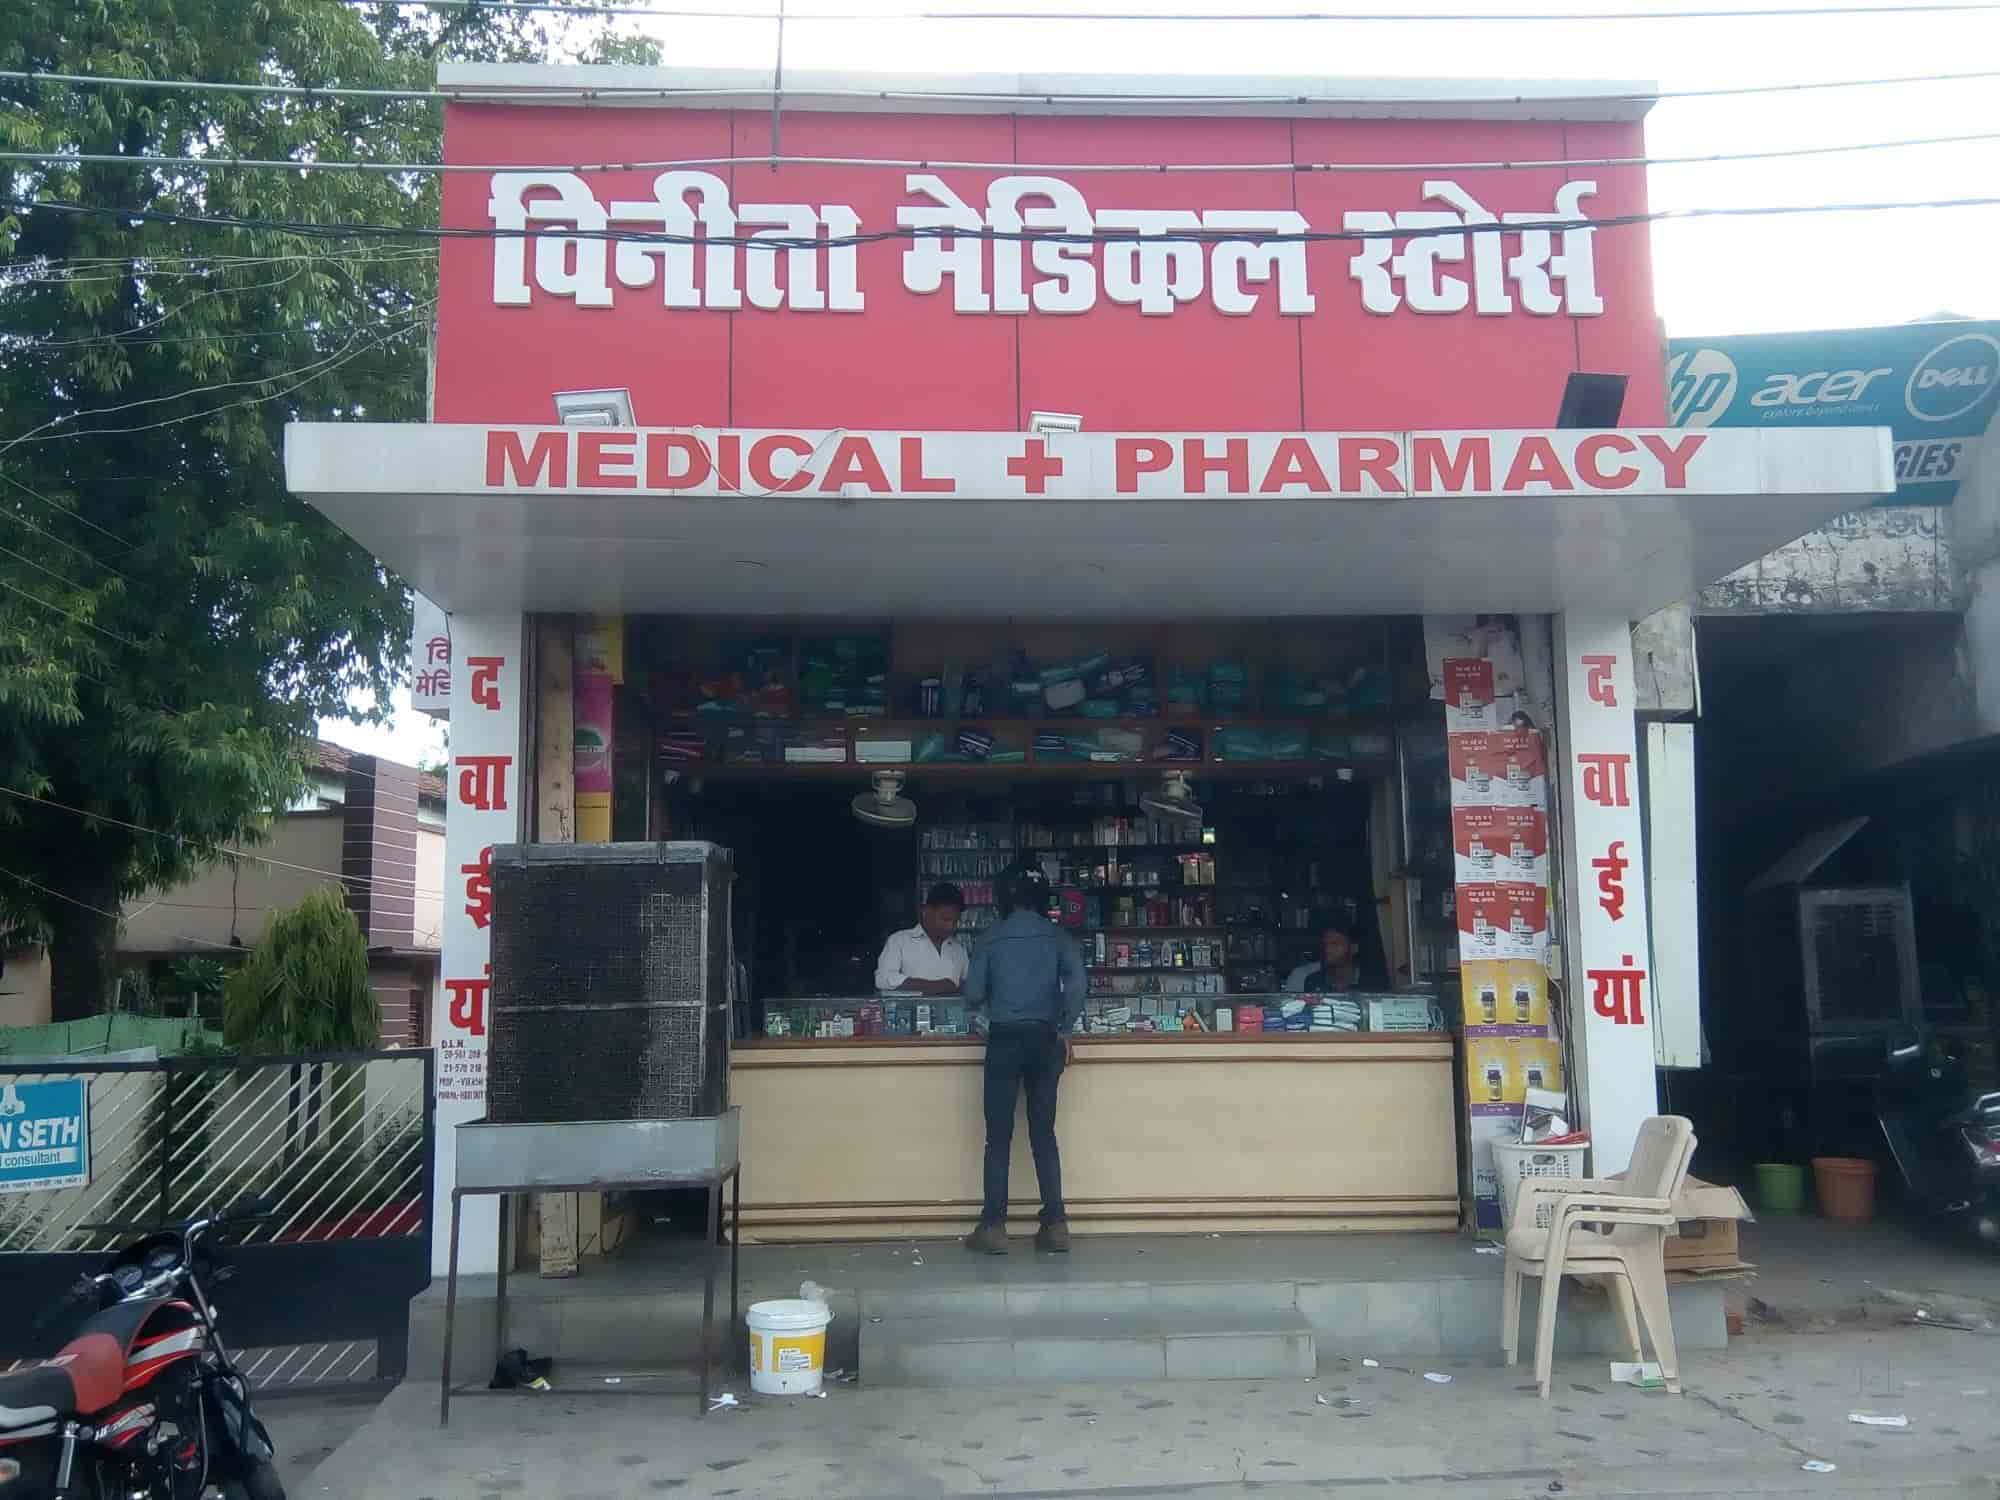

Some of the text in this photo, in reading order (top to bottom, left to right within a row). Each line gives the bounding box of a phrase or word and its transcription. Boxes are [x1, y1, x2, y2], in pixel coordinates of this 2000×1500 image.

[488, 170, 1605, 316] विनीता मेडिकल स्टोर्स
[1751, 366, 1893, 407] acer
[1918, 365, 1988, 390] DELL
[484, 430, 1708, 494] MEDICAL PHARMACY
[17, 1115, 81, 1149] SETH
[5, 1151, 61, 1167] consultant
